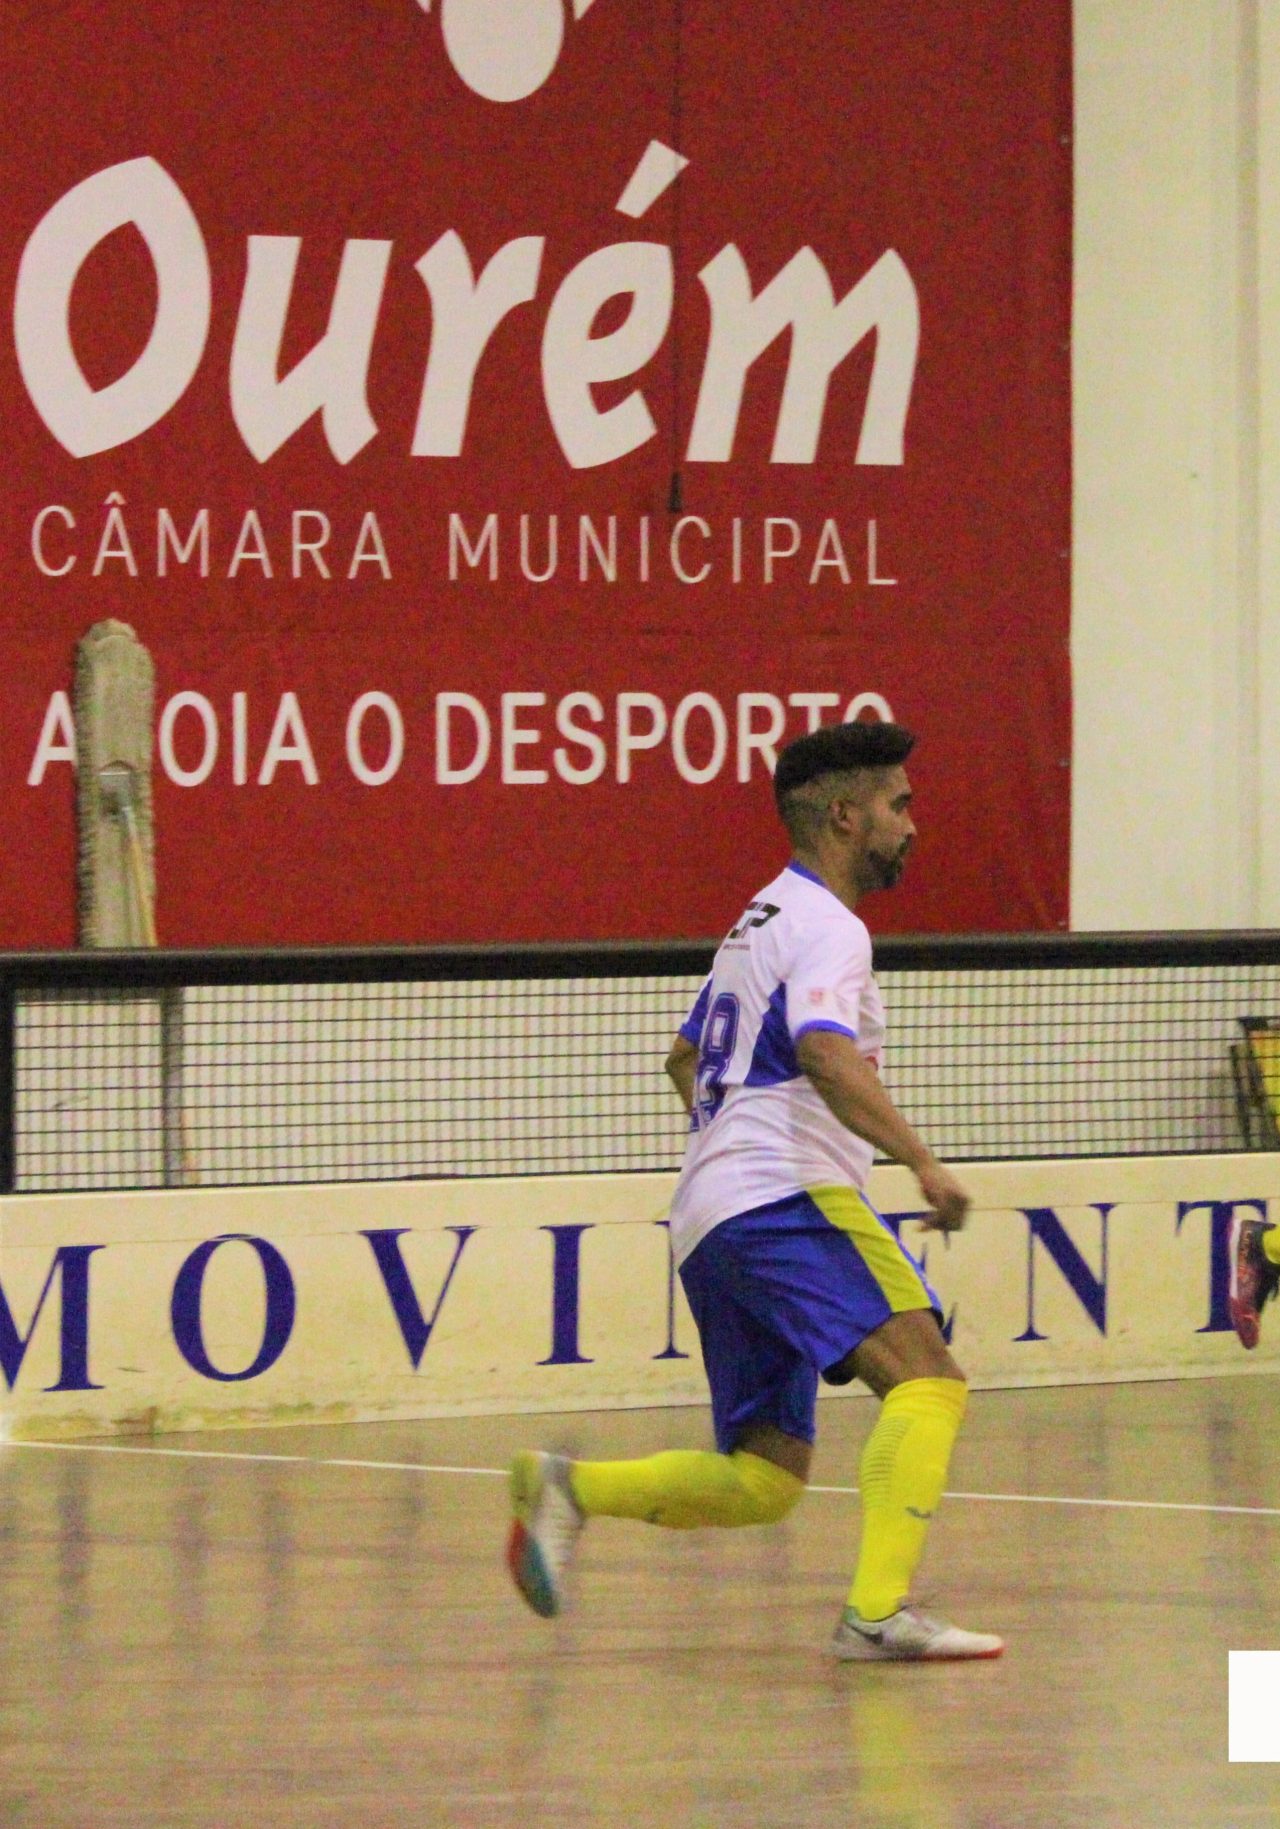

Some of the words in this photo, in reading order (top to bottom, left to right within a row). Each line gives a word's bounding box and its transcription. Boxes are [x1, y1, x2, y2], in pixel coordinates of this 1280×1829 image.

[14, 139, 920, 469] Ourém
[31, 491, 392, 581] CÂMARA
[447, 512, 898, 586] MUNICIPAL
[28, 691, 321, 787] AOIA
[346, 691, 404, 787] O
